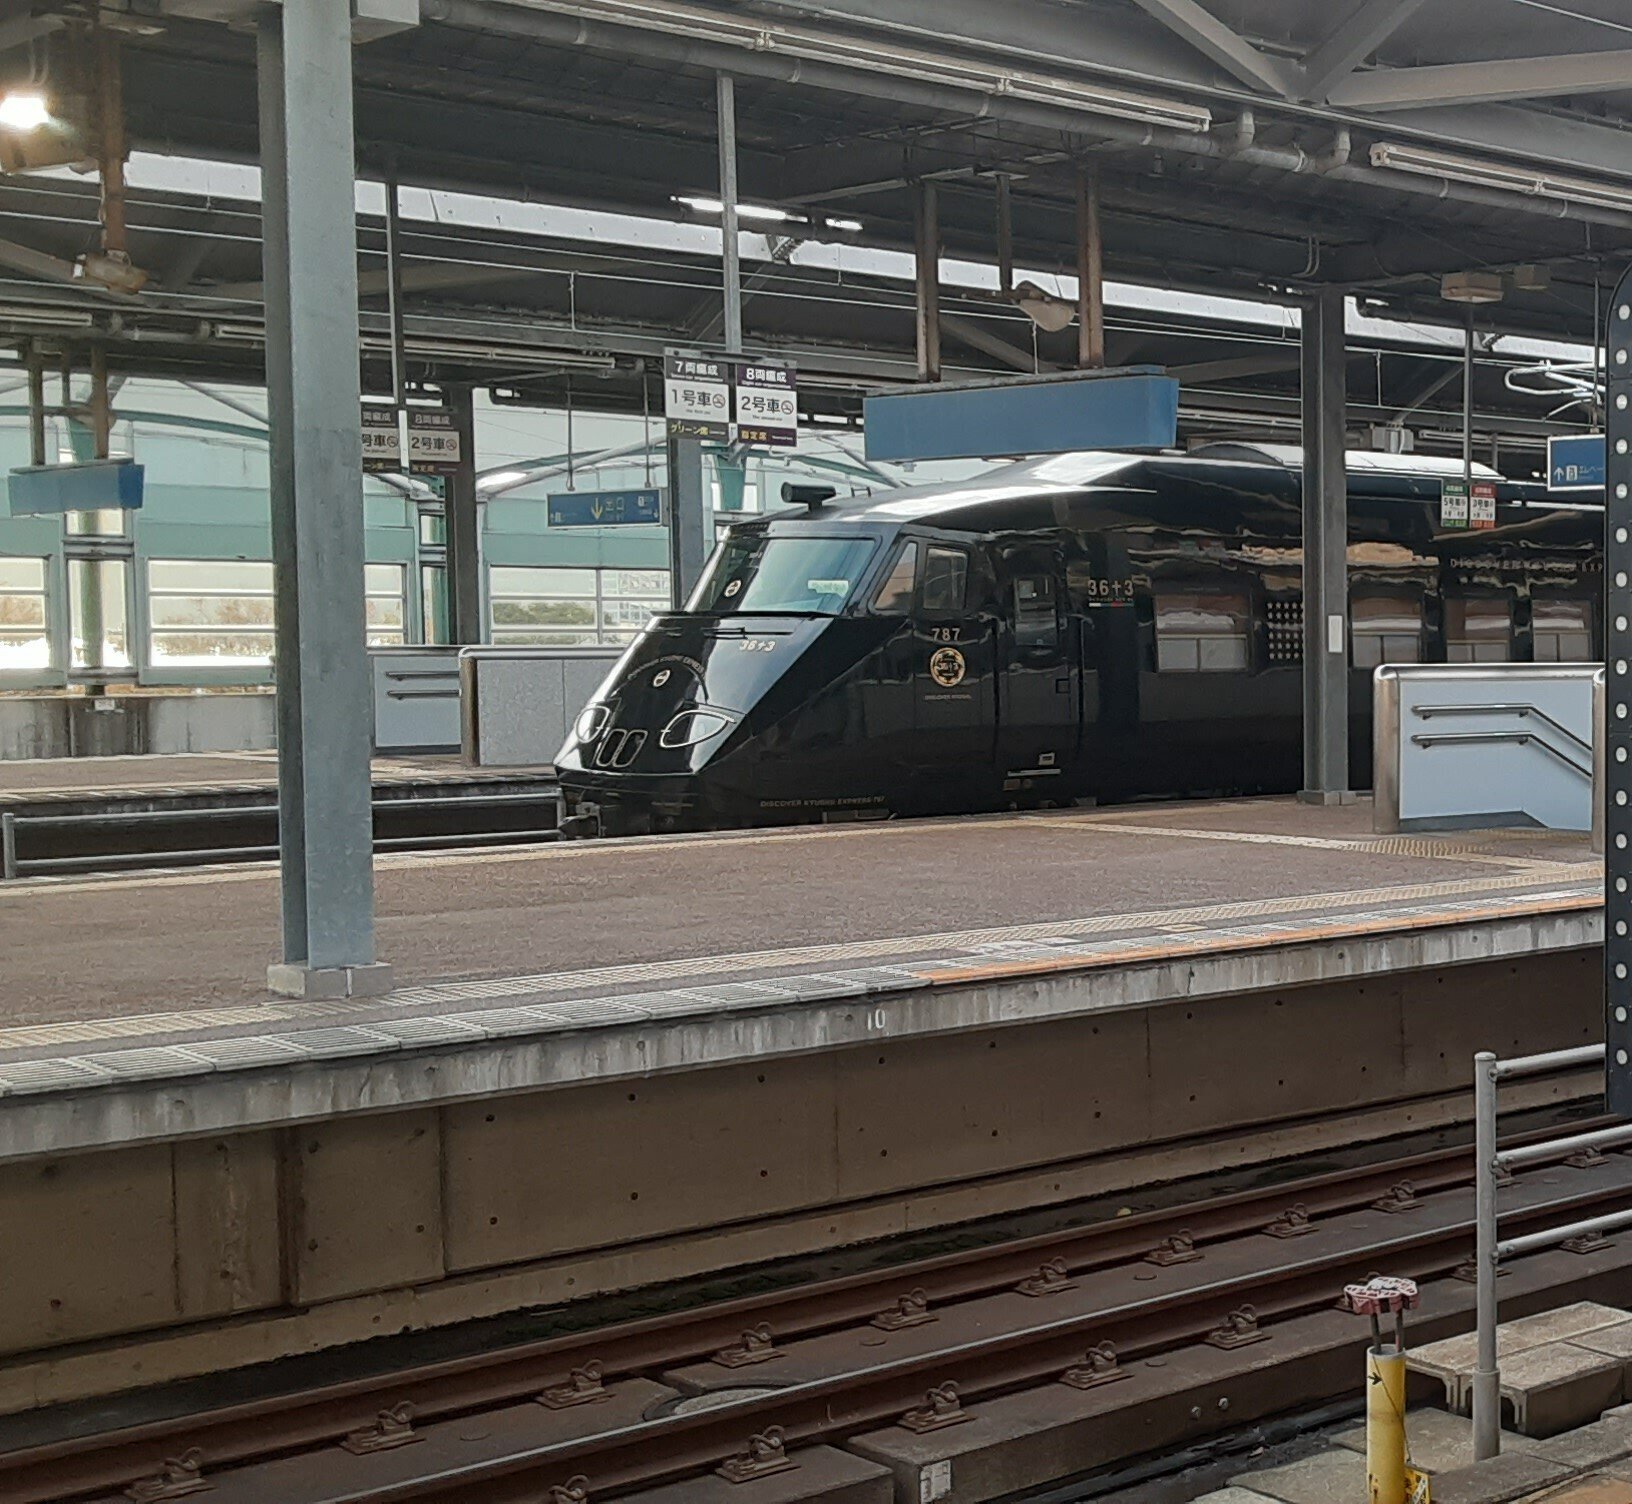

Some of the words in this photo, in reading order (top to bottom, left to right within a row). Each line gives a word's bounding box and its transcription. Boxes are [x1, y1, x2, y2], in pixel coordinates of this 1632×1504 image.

[675, 360, 719, 376] 7両編成
[746, 367, 787, 383] 8両編成
[672, 388, 712, 407] 1号車
[741, 395, 780, 413] 2号車
[412, 436, 447, 450] 2号車
[932, 627, 961, 641] 787
[867, 1008, 886, 1031] 10
